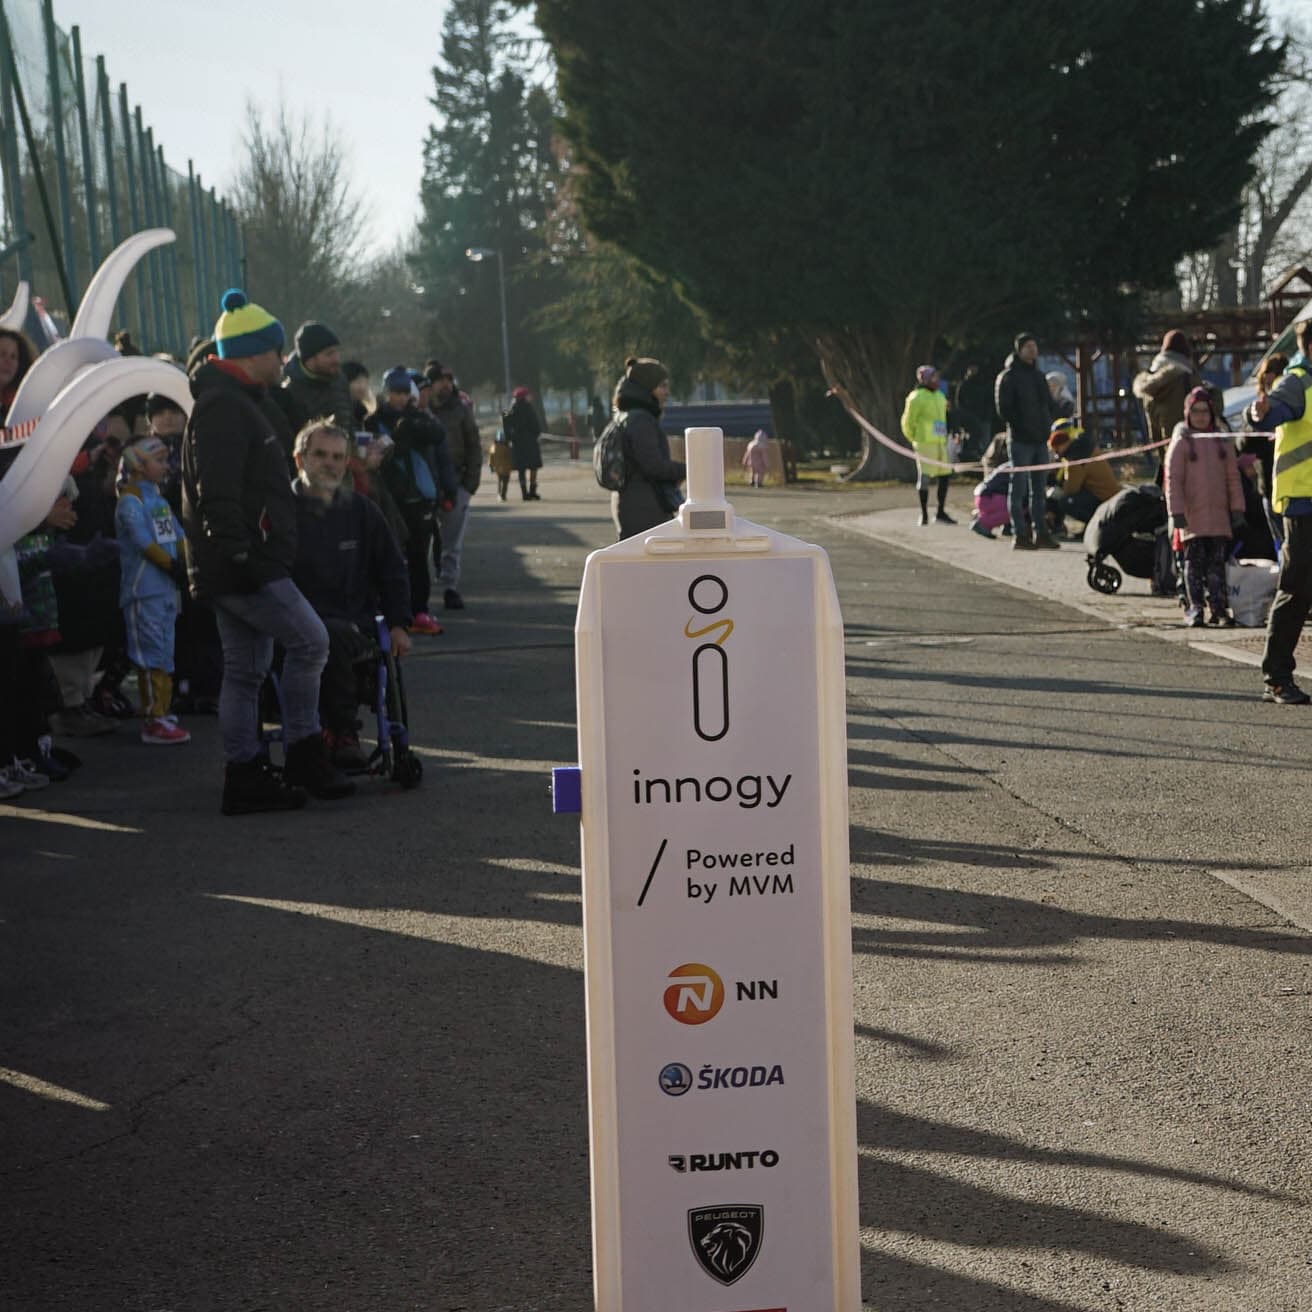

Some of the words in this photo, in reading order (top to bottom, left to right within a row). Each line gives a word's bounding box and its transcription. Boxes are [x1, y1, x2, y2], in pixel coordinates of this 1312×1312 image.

[633, 769, 792, 809] innogy
[686, 844, 795, 870] Powered
[687, 877, 718, 904] by
[729, 873, 794, 897] MVM
[735, 979, 778, 1001] NN
[697, 1064, 785, 1090] ŠKODA
[689, 1149, 780, 1172] RUNTO
[695, 1211, 757, 1222] PEUGEOT
